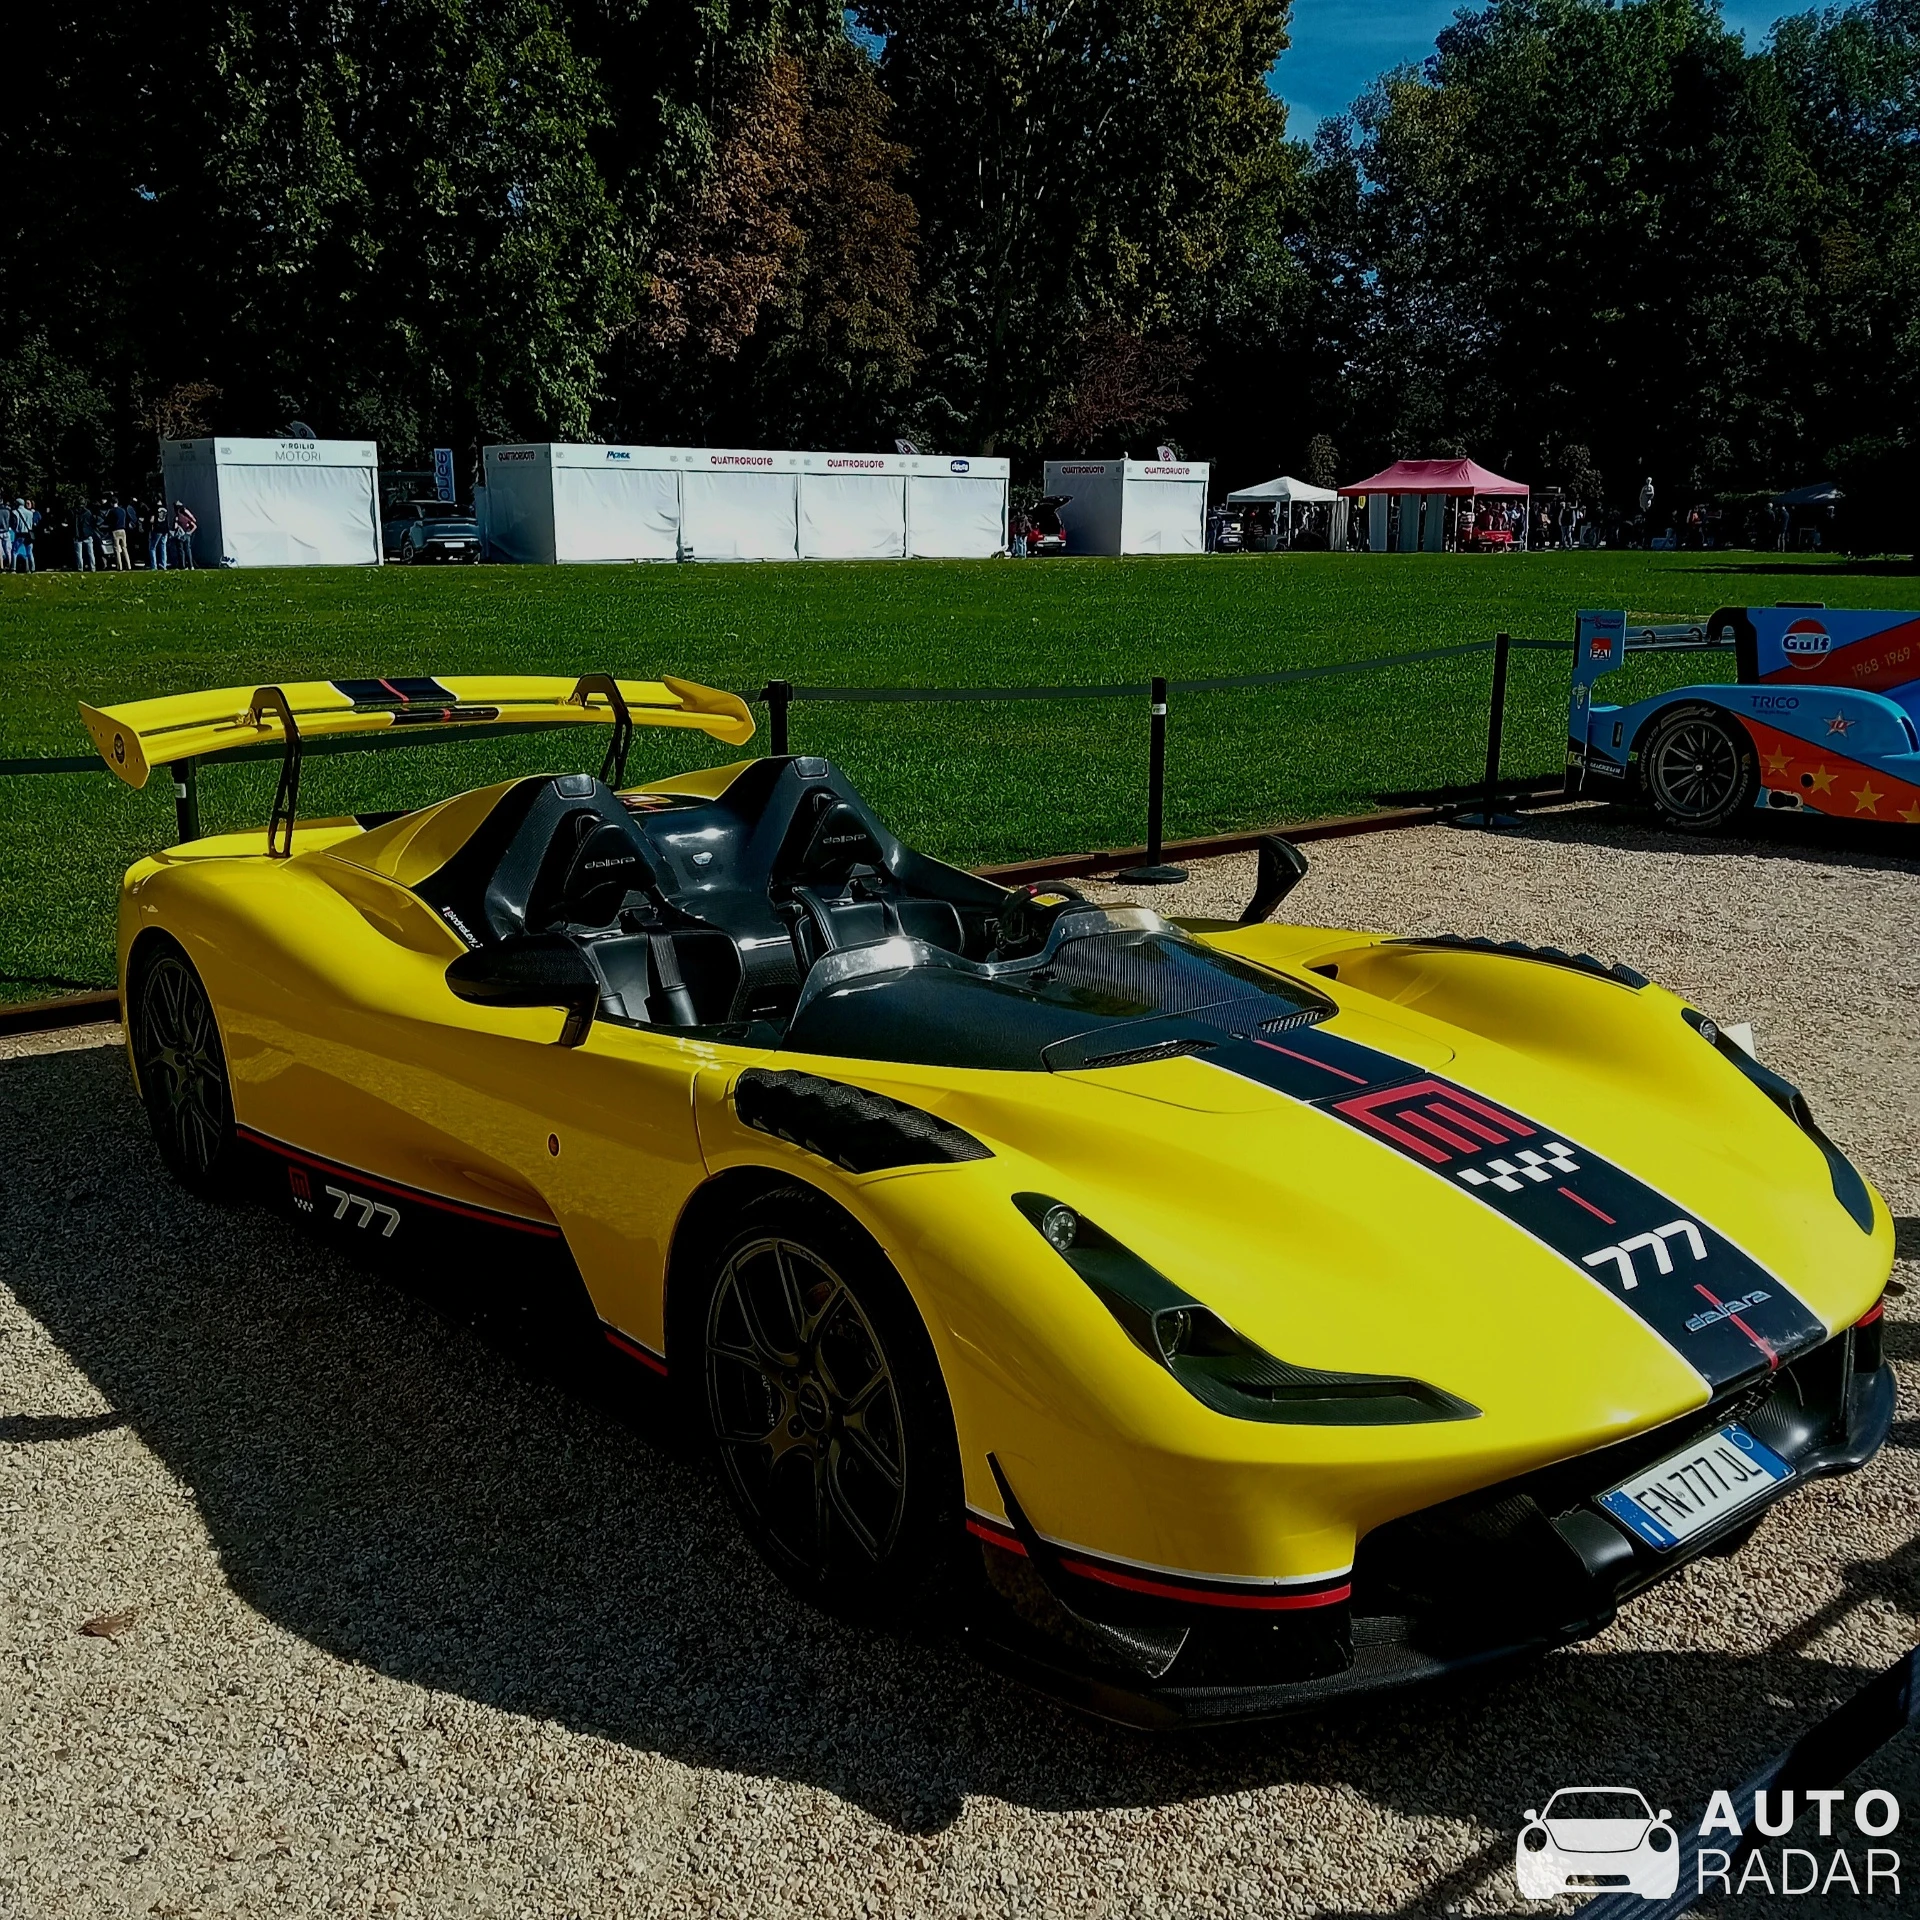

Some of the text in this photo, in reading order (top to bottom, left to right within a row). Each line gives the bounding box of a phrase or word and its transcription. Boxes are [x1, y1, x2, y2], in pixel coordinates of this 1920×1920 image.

[275, 450, 321, 461] MOTORI
[1782, 635, 1830, 651] Gulf
[1851, 658, 1879, 679] 1968
[1884, 646, 1910, 667] 1969
[1750, 695, 1800, 710] TRICO
[823, 834, 867, 844] dallara
[584, 856, 636, 869] dallara
[325, 1184, 401, 1238] 777
[1581, 1219, 1709, 1291] 777
[1683, 1290, 1773, 1333] dallara
